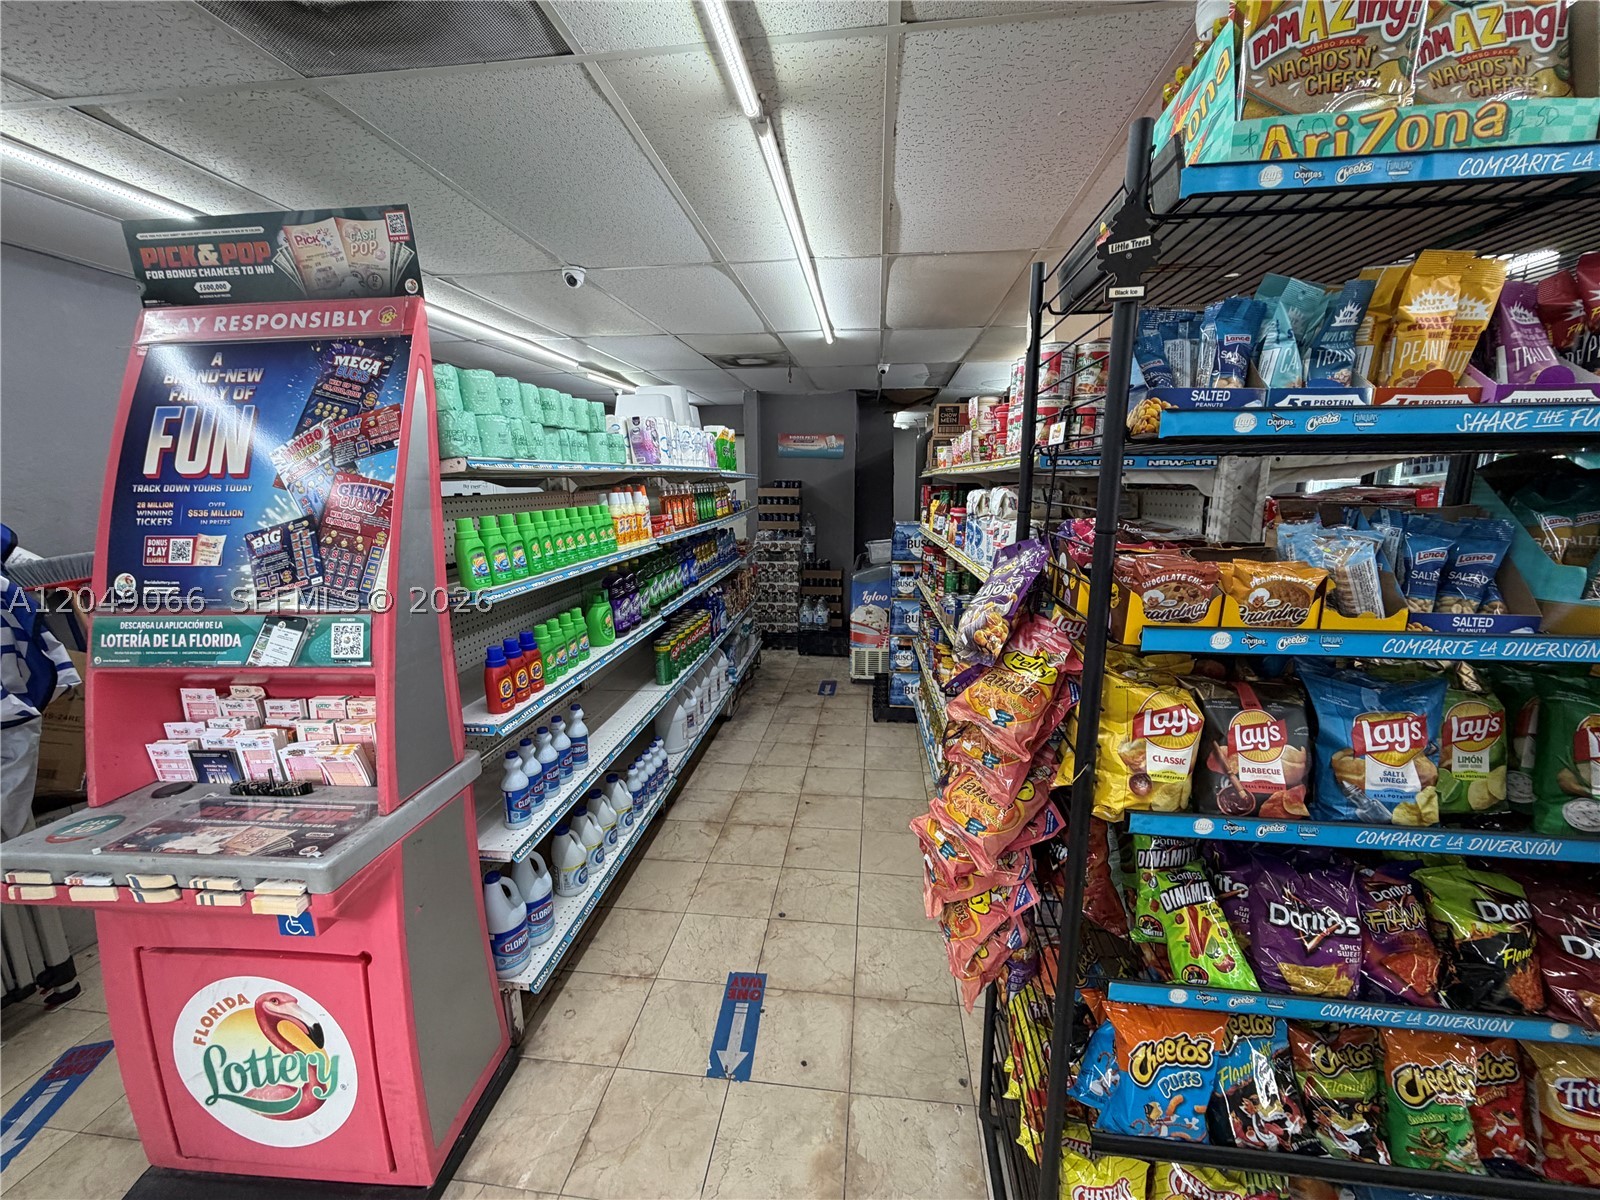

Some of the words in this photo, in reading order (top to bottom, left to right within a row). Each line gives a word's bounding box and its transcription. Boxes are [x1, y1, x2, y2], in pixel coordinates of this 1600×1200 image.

[1305, 41, 1337, 54] COMBO
[1339, 38, 1363, 47] PACK
[1461, 52, 1490, 63] COMBO
[1492, 49, 1515, 57] PACK
[1267, 49, 1350, 87] NACHOS
[1428, 58, 1507, 90] NACHOS
[1304, 68, 1380, 96] CHEESE
[1466, 76, 1538, 98] CHEESE
[1260, 101, 1508, 161] AriZona
[1294, 170, 1323, 180] Doritos
[1335, 161, 1374, 184] Cheetos
[1458, 152, 1570, 177] COMPARTE
[1572, 150, 1594, 167] LA
[349, 229, 377, 241] CASH
[350, 240, 378, 256] POP
[1110, 241, 1130, 253] Little
[1130, 238, 1150, 248] Trees
[145, 270, 165, 280] FOR
[166, 268, 198, 279] BONUS
[198, 266, 240, 278] CHANCES
[241, 266, 254, 275] TO
[254, 265, 274, 274] WIN
[1418, 297, 1444, 306] NUT
[213, 308, 373, 332] RESPONSIBLY
[1415, 316, 1455, 324] HONEY
[1226, 335, 1250, 343] Lance
[211, 352, 223, 366] A
[334, 355, 382, 376] MEGA
[163, 368, 265, 384] BRND-NEW
[335, 365, 371, 383] BUCKS
[233, 386, 256, 400] OF
[1190, 390, 1231, 402] SALTED
[333, 418, 362, 434] LUCKY
[1266, 417, 1295, 427] Doritos
[1305, 413, 1341, 431] Cheetos
[1456, 411, 1533, 432] SHARE
[1536, 411, 1569, 424] THE
[143, 405, 256, 478] FUN
[132, 484, 161, 493] TRACK
[163, 484, 190, 493] DOWN
[193, 484, 222, 492] YOURS
[225, 484, 253, 492] TODAY
[339, 484, 391, 504] GIANT
[340, 496, 377, 513] BUCKS
[210, 509, 243, 517] MILLION
[136, 518, 173, 526] TICKETS
[147, 538, 168, 546] BONUS
[253, 530, 282, 549] BIG
[147, 547, 167, 556] PLAY
[1417, 551, 1446, 562] Lance
[1457, 554, 1495, 564] Lance
[1141, 573, 1187, 589] CHOCOLATE
[1448, 571, 1489, 584] SALTED
[862, 591, 888, 604] Igloo
[120, 621, 155, 630] DESCARGA
[155, 621, 164, 629] LA
[164, 618, 204, 629] APLICACIÓN
[204, 621, 214, 629] DE
[214, 621, 223, 629] LA
[1452, 617, 1494, 628] SALTED
[100, 630, 151, 648] LOTERÍA
[153, 634, 169, 647] DE
[171, 634, 187, 647] LA
[189, 633, 242, 647] FLORIDA
[1241, 637, 1266, 645] Doritos
[1276, 634, 1309, 650] Cheetos
[1382, 638, 1479, 656] COMPARTE
[1479, 640, 1498, 654] LA
[1501, 640, 1600, 658] DIVERSIÓN
[893, 654, 914, 662] BUSCH
[1143, 704, 1200, 736] Lay's
[1234, 720, 1281, 752] Lay's
[1361, 717, 1422, 753] Lay's
[1451, 714, 1500, 743] Lay's
[1152, 755, 1187, 766] CLASSIC
[1458, 754, 1483, 764] LIMÓN
[1241, 766, 1282, 776] BARBECUE
[1379, 776, 1408, 784] VINEGAR
[1256, 823, 1287, 837] Cheetos
[1355, 830, 1442, 848] COMPARTE
[1446, 835, 1465, 848] LA
[1467, 837, 1563, 856] DIVERSIÓN
[1169, 871, 1202, 881] Doritos
[1369, 884, 1413, 902] Doritos
[1269, 901, 1361, 935] Doritos
[533, 968, 550, 990] NOW
[728, 988, 762, 1002] ONE
[1228, 997, 1256, 1008] Cheetos
[1320, 1004, 1405, 1023] COMPARTE
[1406, 1012, 1422, 1024] LA
[193, 993, 250, 1046] FLORIDA
[1128, 1035, 1214, 1087] Cheetos
[1312, 1042, 1374, 1077] Cheetos
[203, 1044, 340, 1115] Lottery
[1158, 1072, 1202, 1099] PUFFS
[1393, 1062, 1477, 1108] Cheetos
